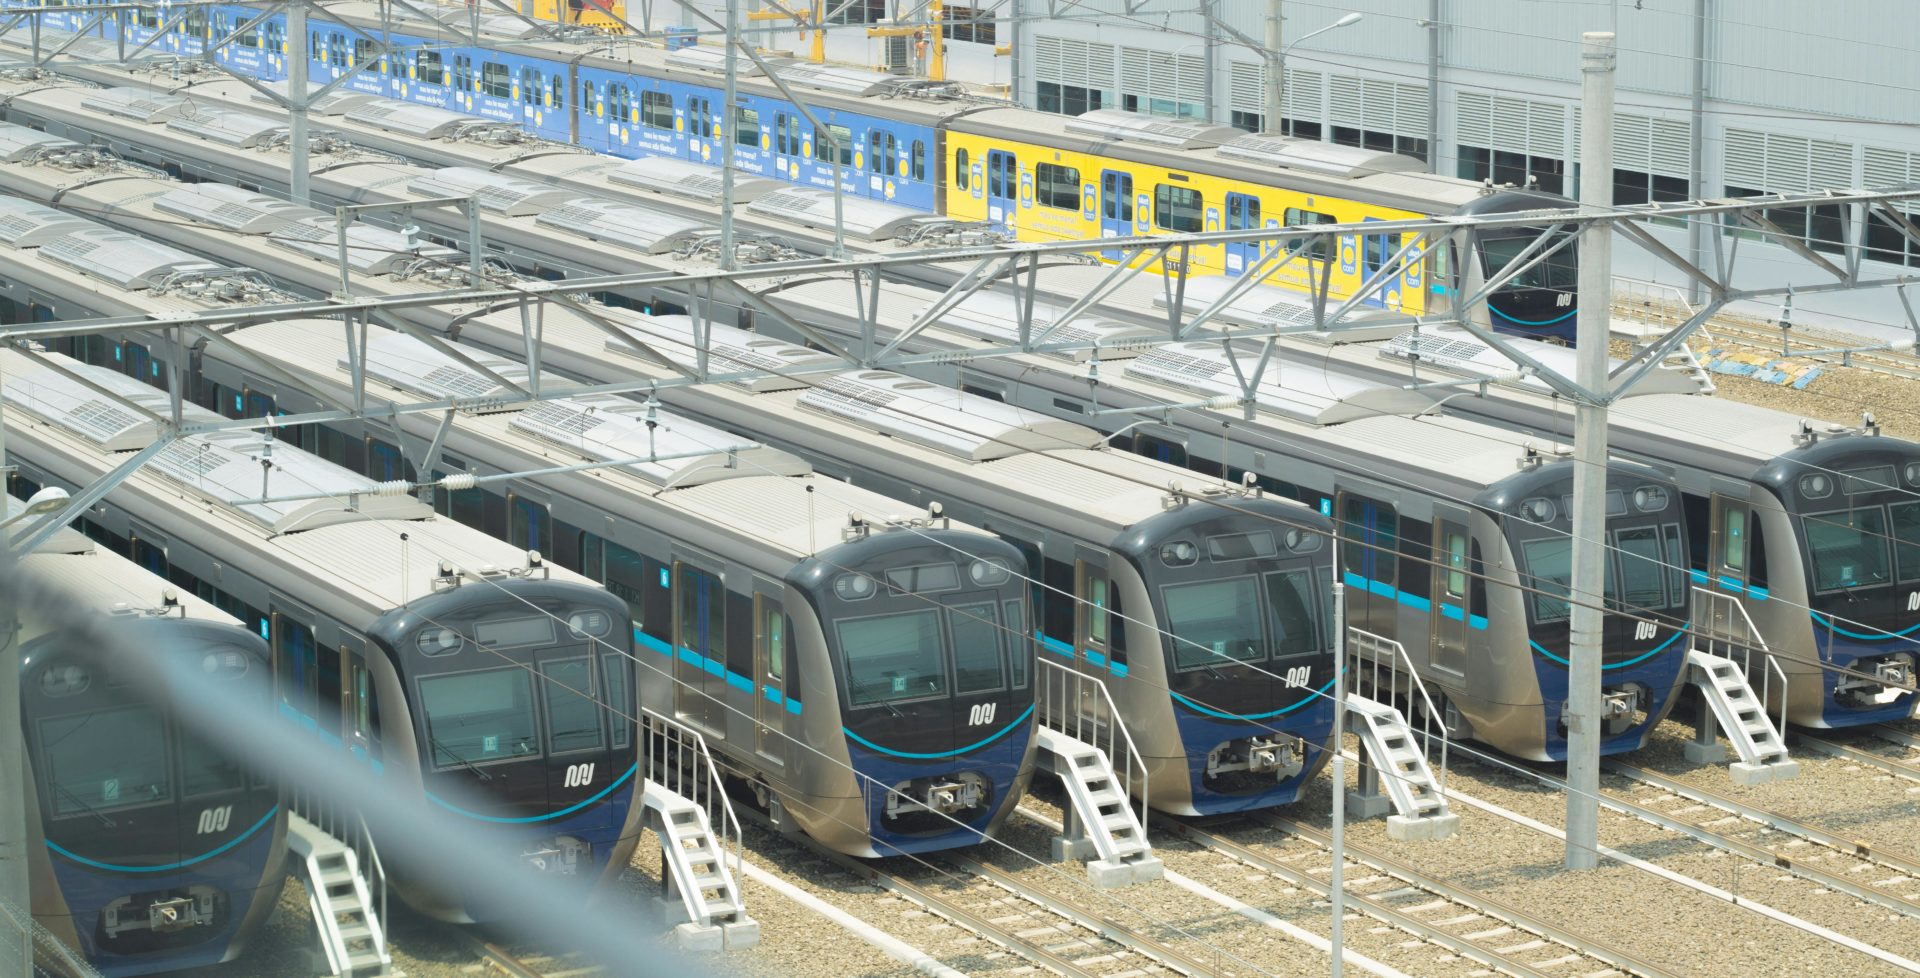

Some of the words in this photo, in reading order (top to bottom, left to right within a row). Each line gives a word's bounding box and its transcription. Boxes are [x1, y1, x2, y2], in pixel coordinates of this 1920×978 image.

[1138, 196, 1149, 205] tiket
[1207, 210, 1219, 219] tiket
[1342, 236, 1355, 246] tiket
[1342, 265, 1355, 273] com
[1407, 278, 1420, 286] com
